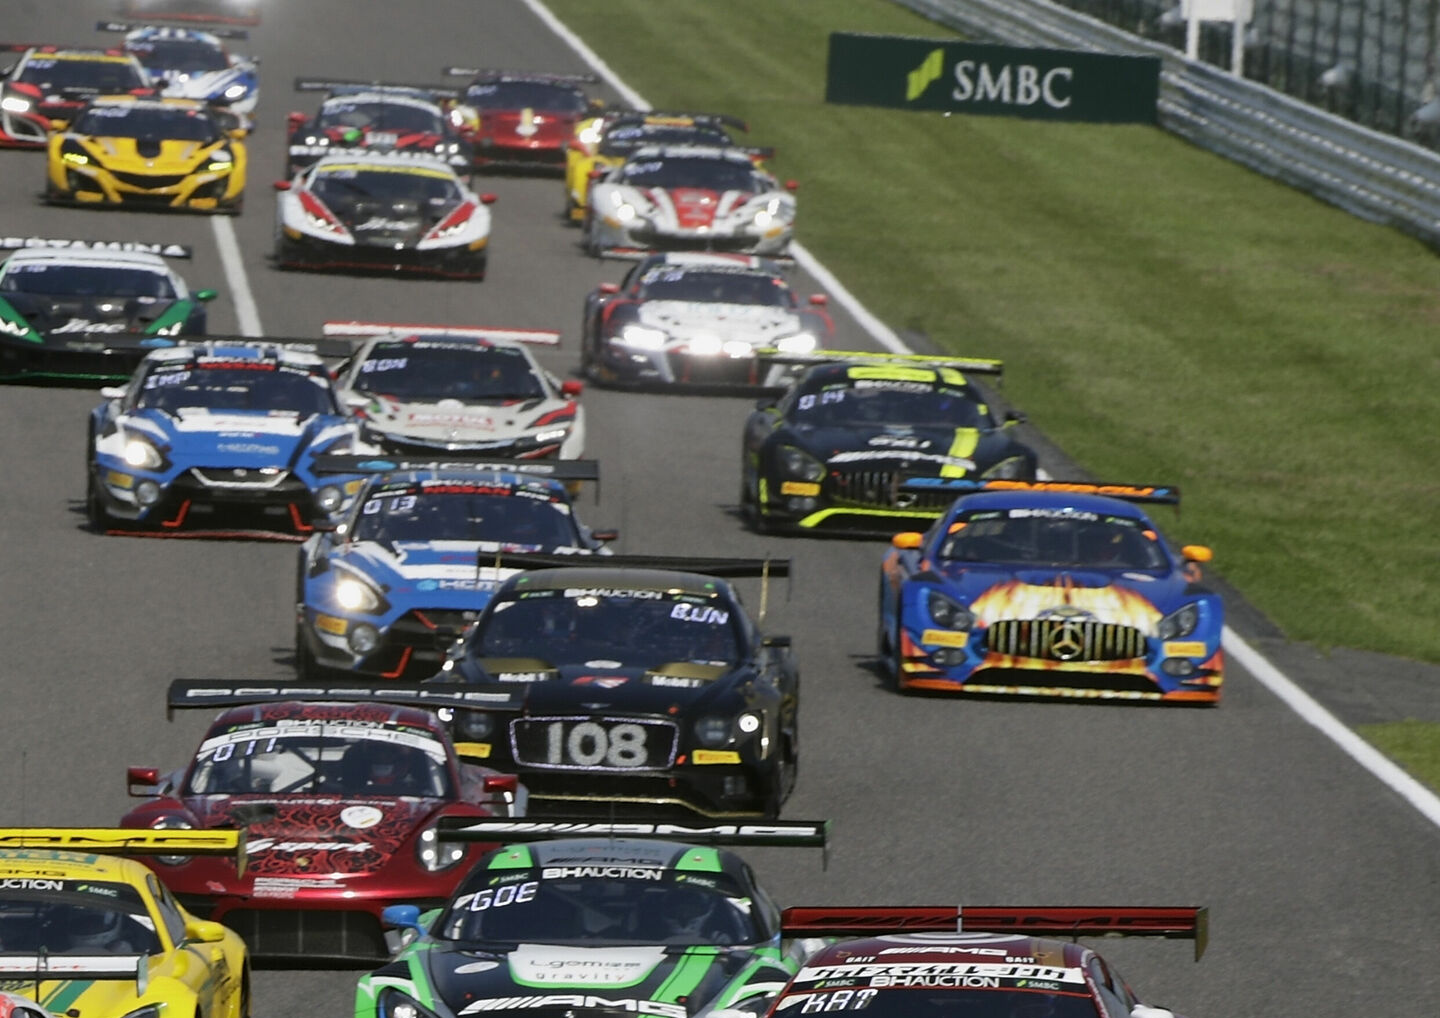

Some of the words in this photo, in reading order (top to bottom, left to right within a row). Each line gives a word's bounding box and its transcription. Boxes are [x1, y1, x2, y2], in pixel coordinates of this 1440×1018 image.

[953, 60, 1073, 108] SMBC
[186, 688, 510, 701] PORSCHE
[229, 727, 421, 742] PORSCHE
[212, 737, 276, 762] 011
[547, 722, 648, 768] 108
[542, 867, 662, 880] BHAUCTION
[470, 881, 539, 912] GOE
[536, 972, 625, 982] gravity
[869, 975, 1000, 988] BHAUCTION
[800, 989, 879, 1014] KAT
